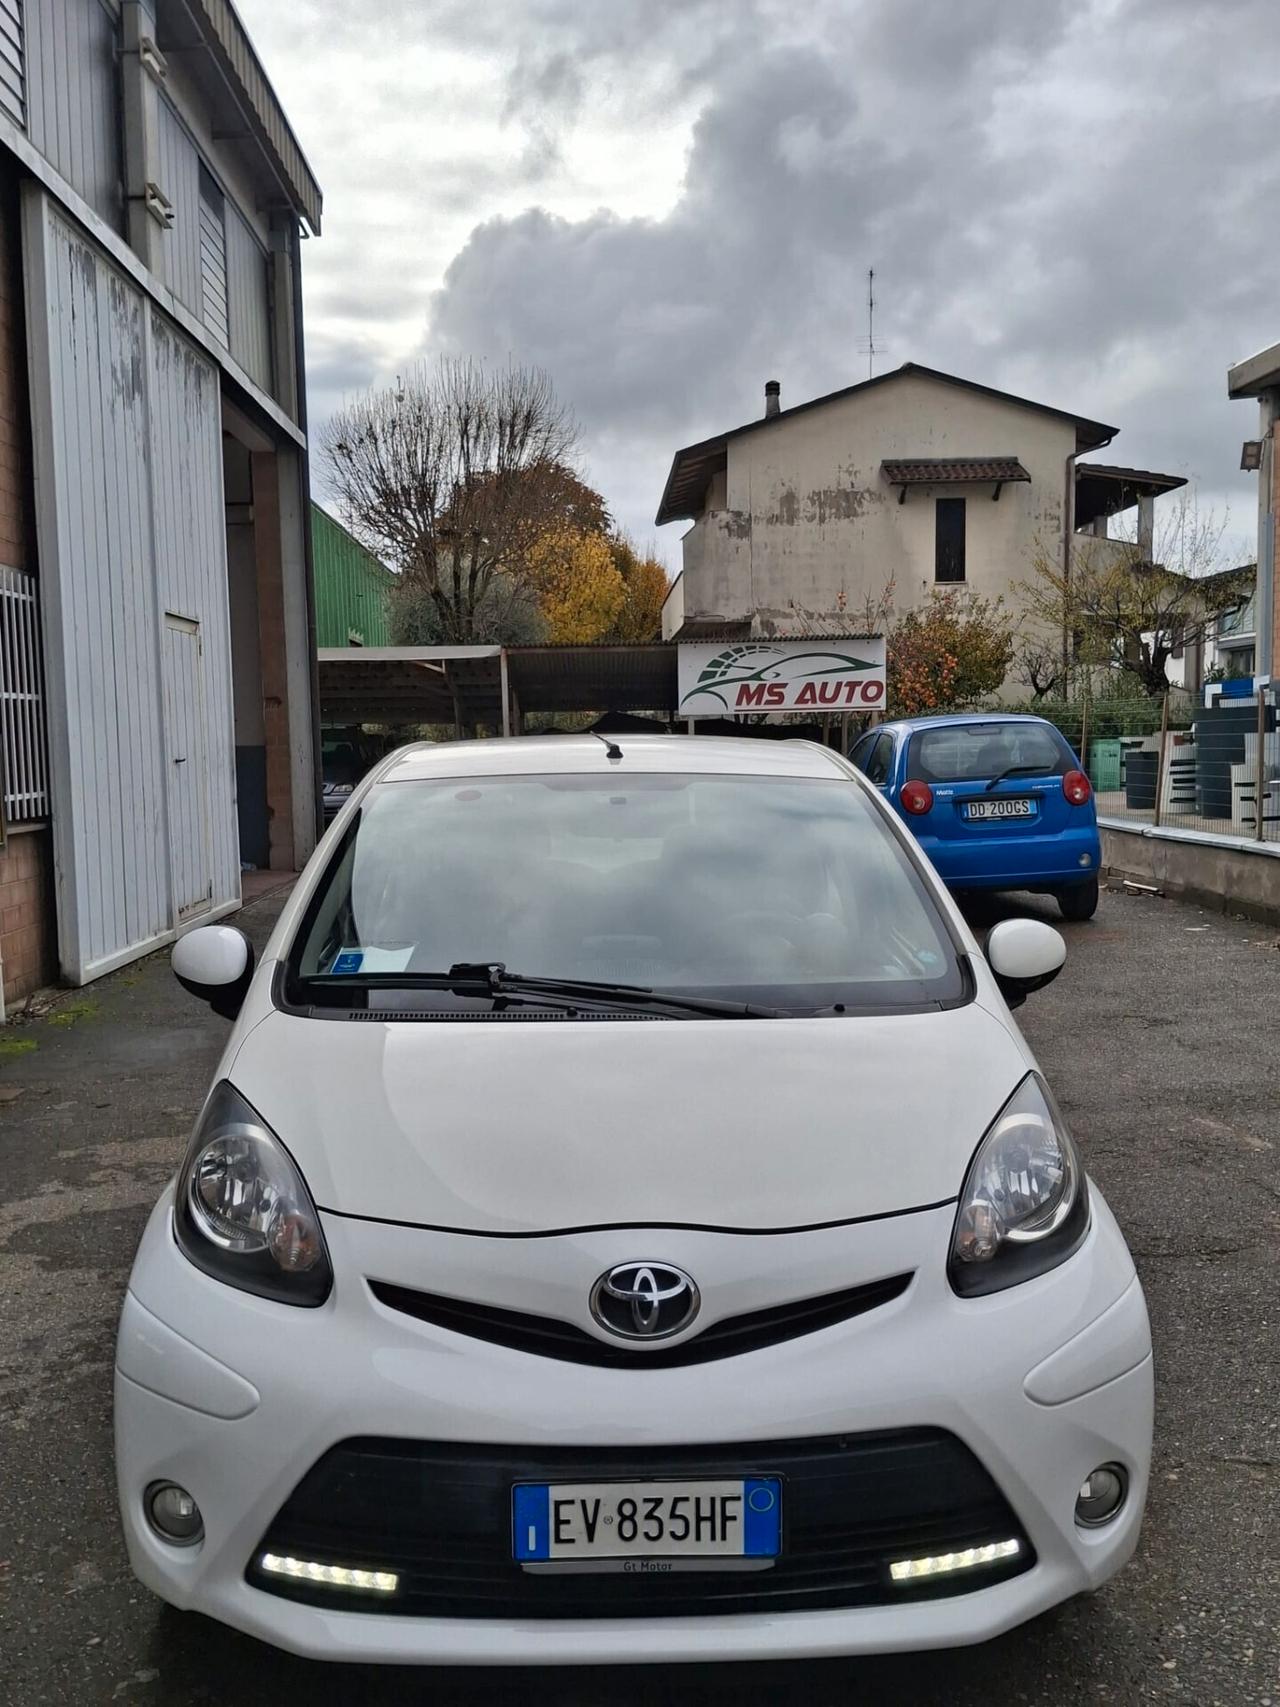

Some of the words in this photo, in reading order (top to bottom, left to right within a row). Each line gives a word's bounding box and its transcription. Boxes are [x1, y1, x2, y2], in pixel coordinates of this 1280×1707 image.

[735, 682, 789, 706] MS
[794, 680, 884, 705] AUTO
[970, 802, 986, 817] DD
[990, 800, 1029, 815] 200GS
[553, 1498, 601, 1544] EV
[617, 1496, 742, 1542] 835HF
[528, 1525, 536, 1551] I
[623, 1561, 636, 1572] Gt
[640, 1561, 673, 1571] Motor
